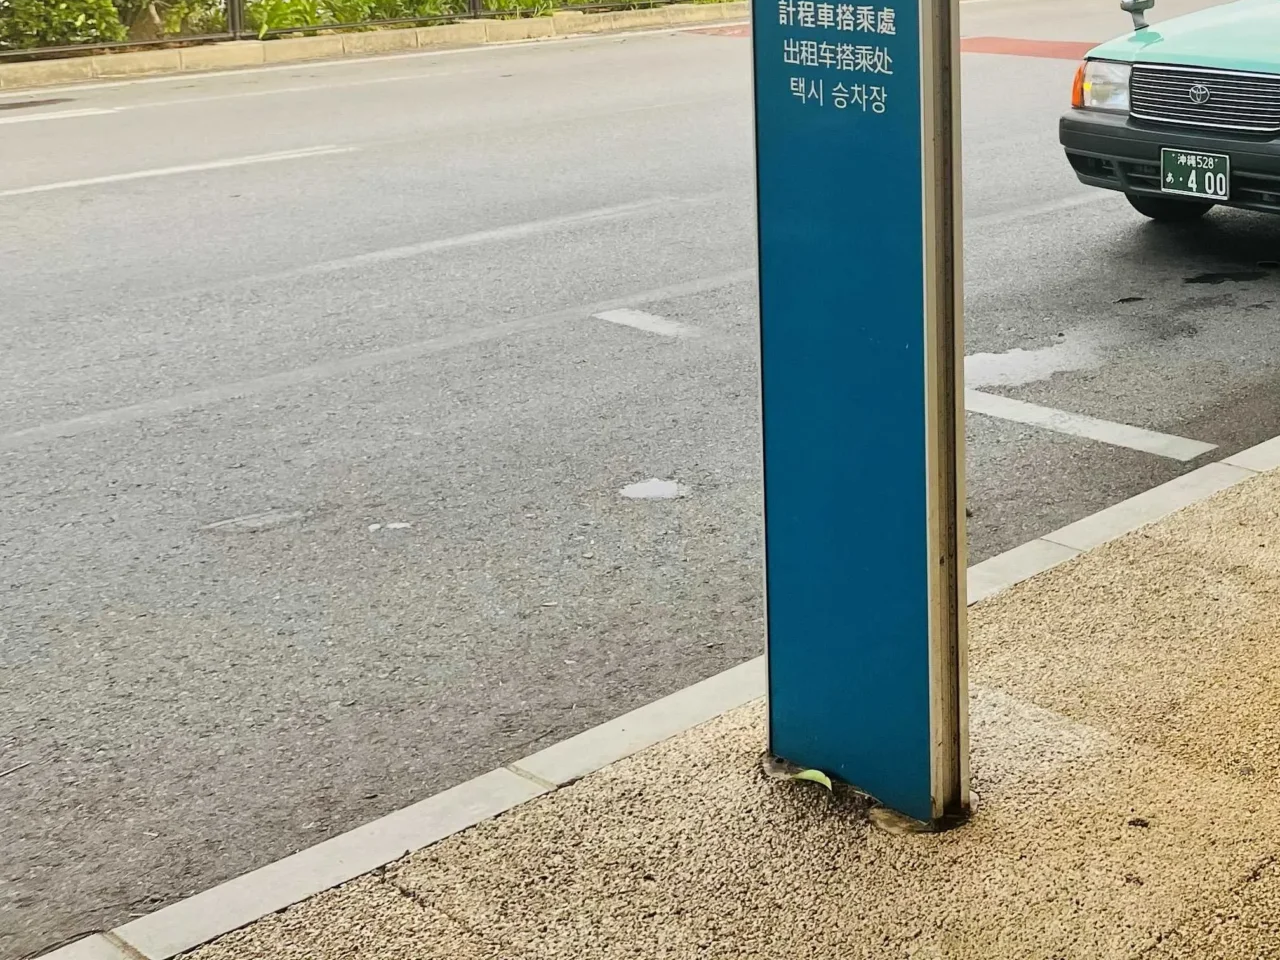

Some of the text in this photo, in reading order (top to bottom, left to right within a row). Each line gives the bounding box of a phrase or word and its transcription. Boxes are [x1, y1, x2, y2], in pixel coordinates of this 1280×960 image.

[783, 37, 894, 76] 出租车搭乘处
[789, 76, 888, 115] 택시 승차장
